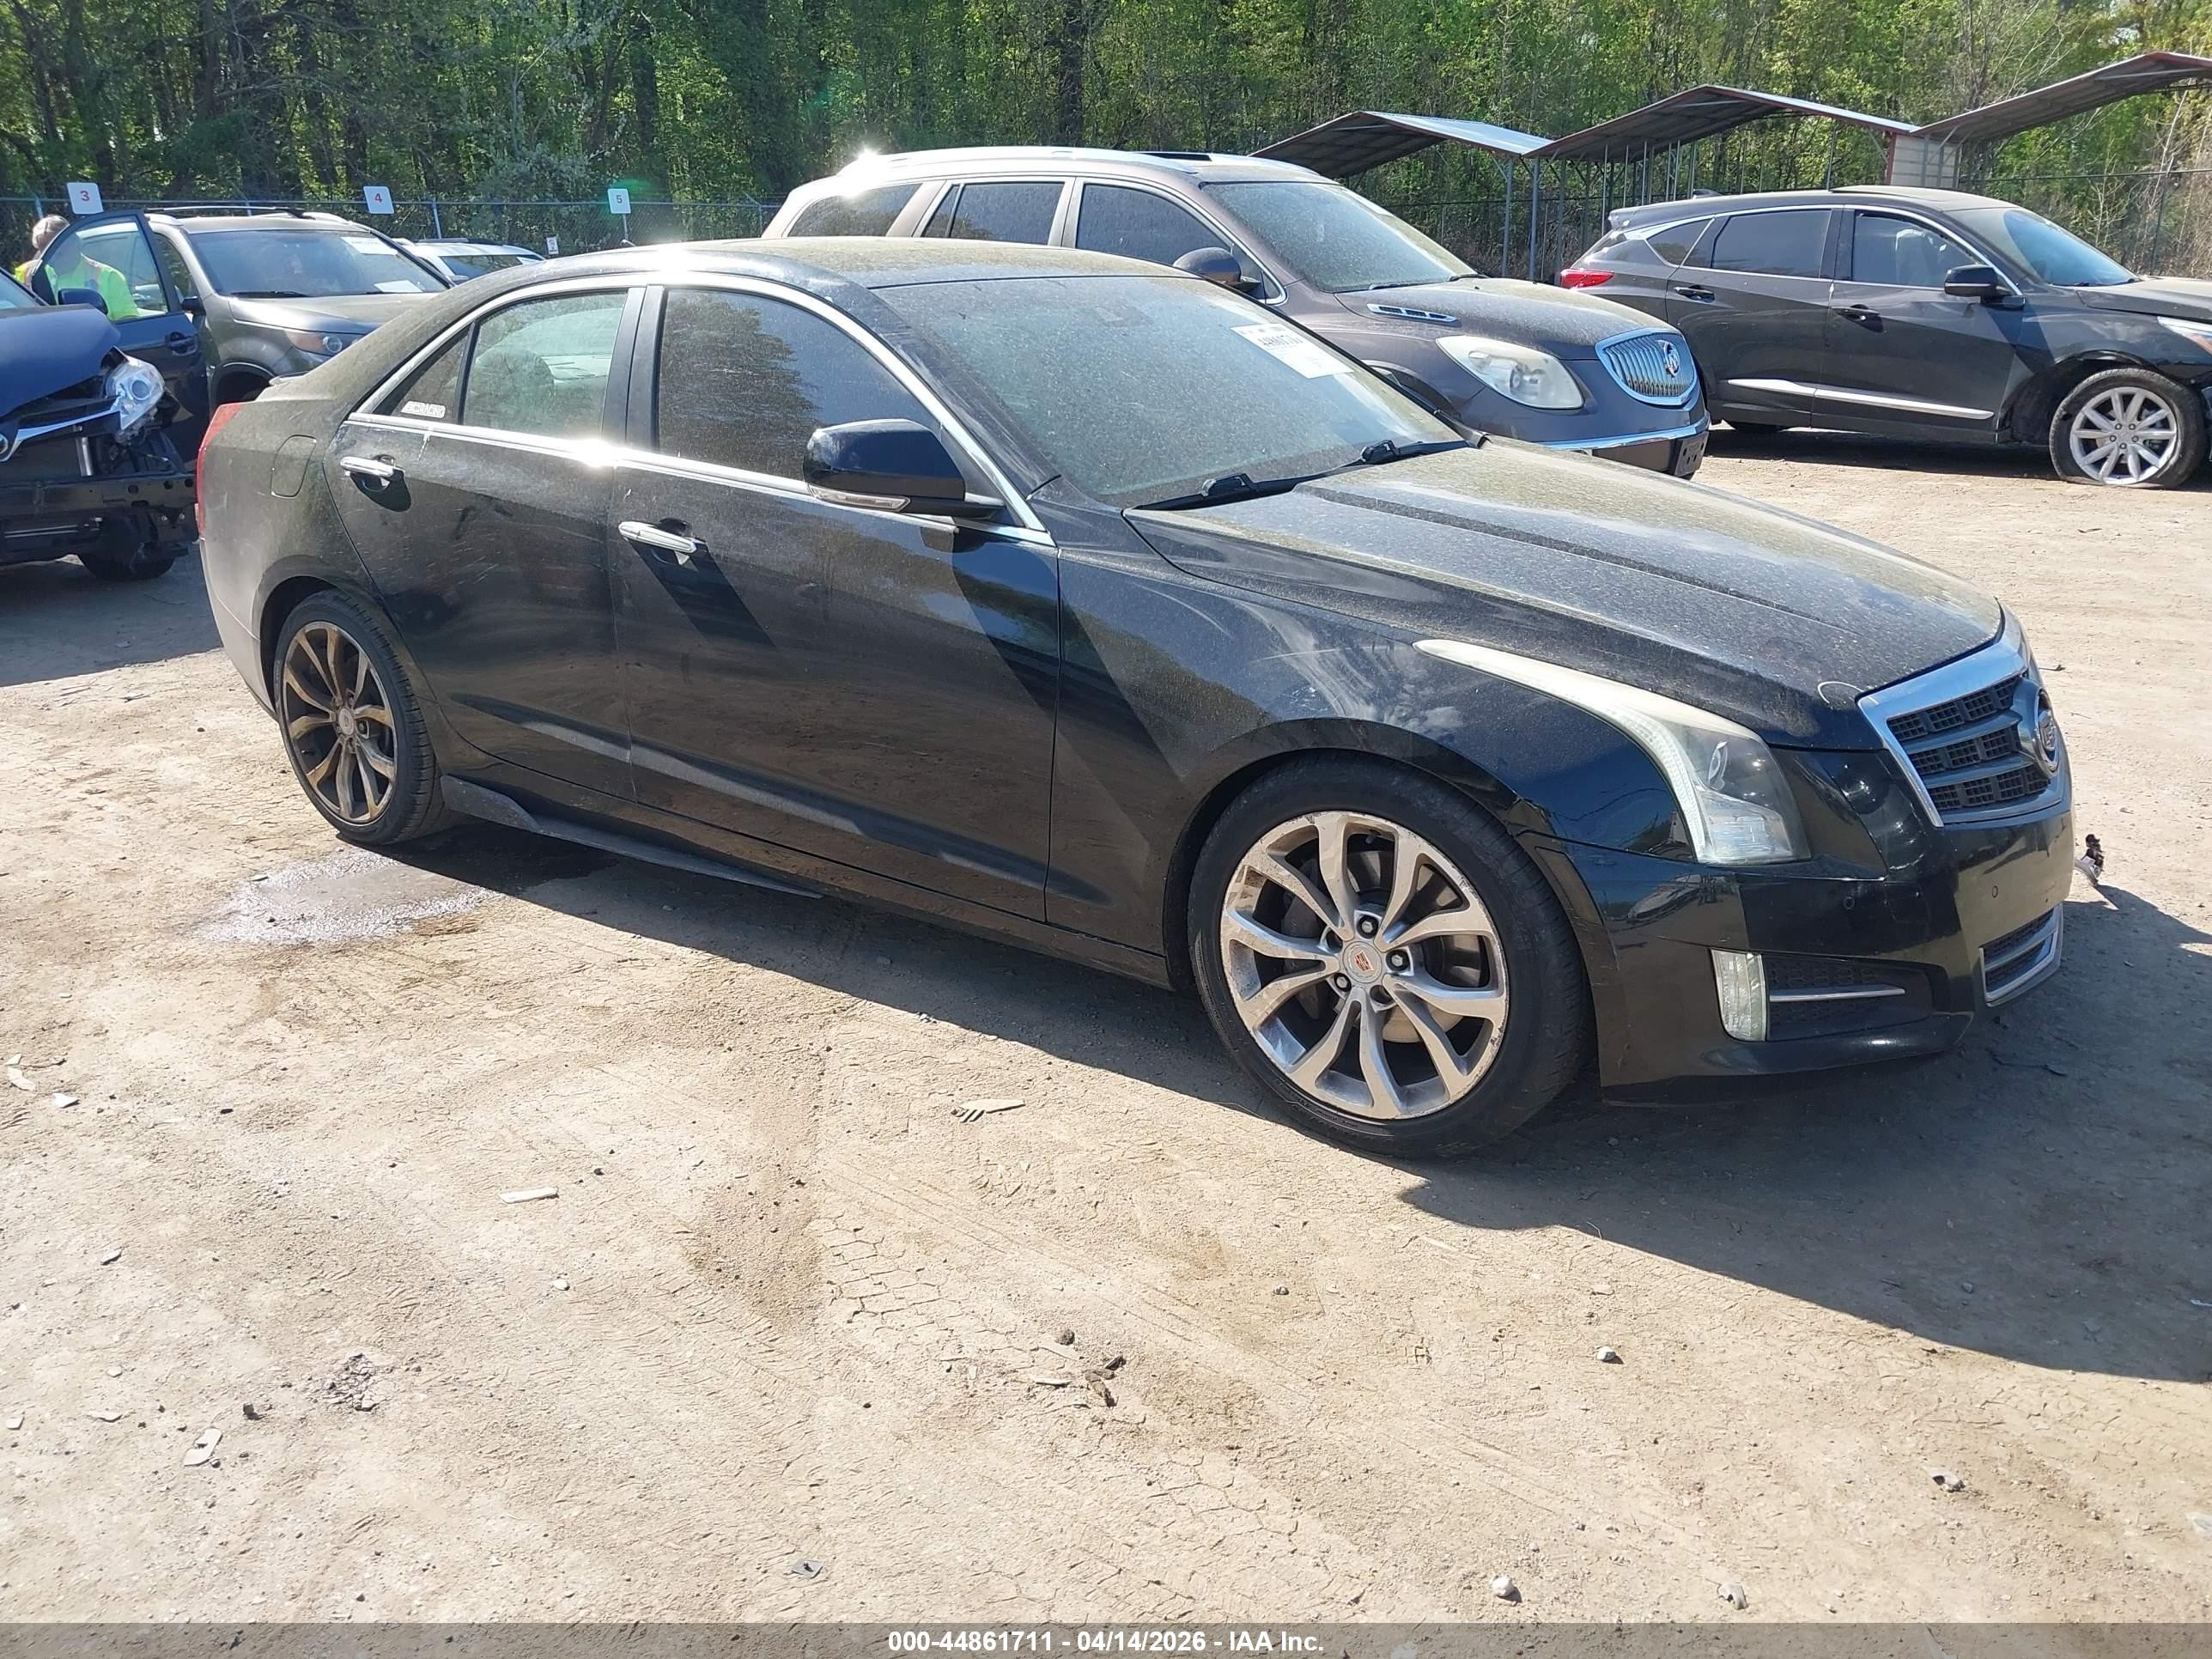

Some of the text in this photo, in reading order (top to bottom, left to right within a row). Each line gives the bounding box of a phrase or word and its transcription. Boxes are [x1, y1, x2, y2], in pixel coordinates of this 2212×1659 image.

[80, 190, 90, 202] 3
[374, 192, 383, 204] 4
[616, 194, 623, 204] 5
